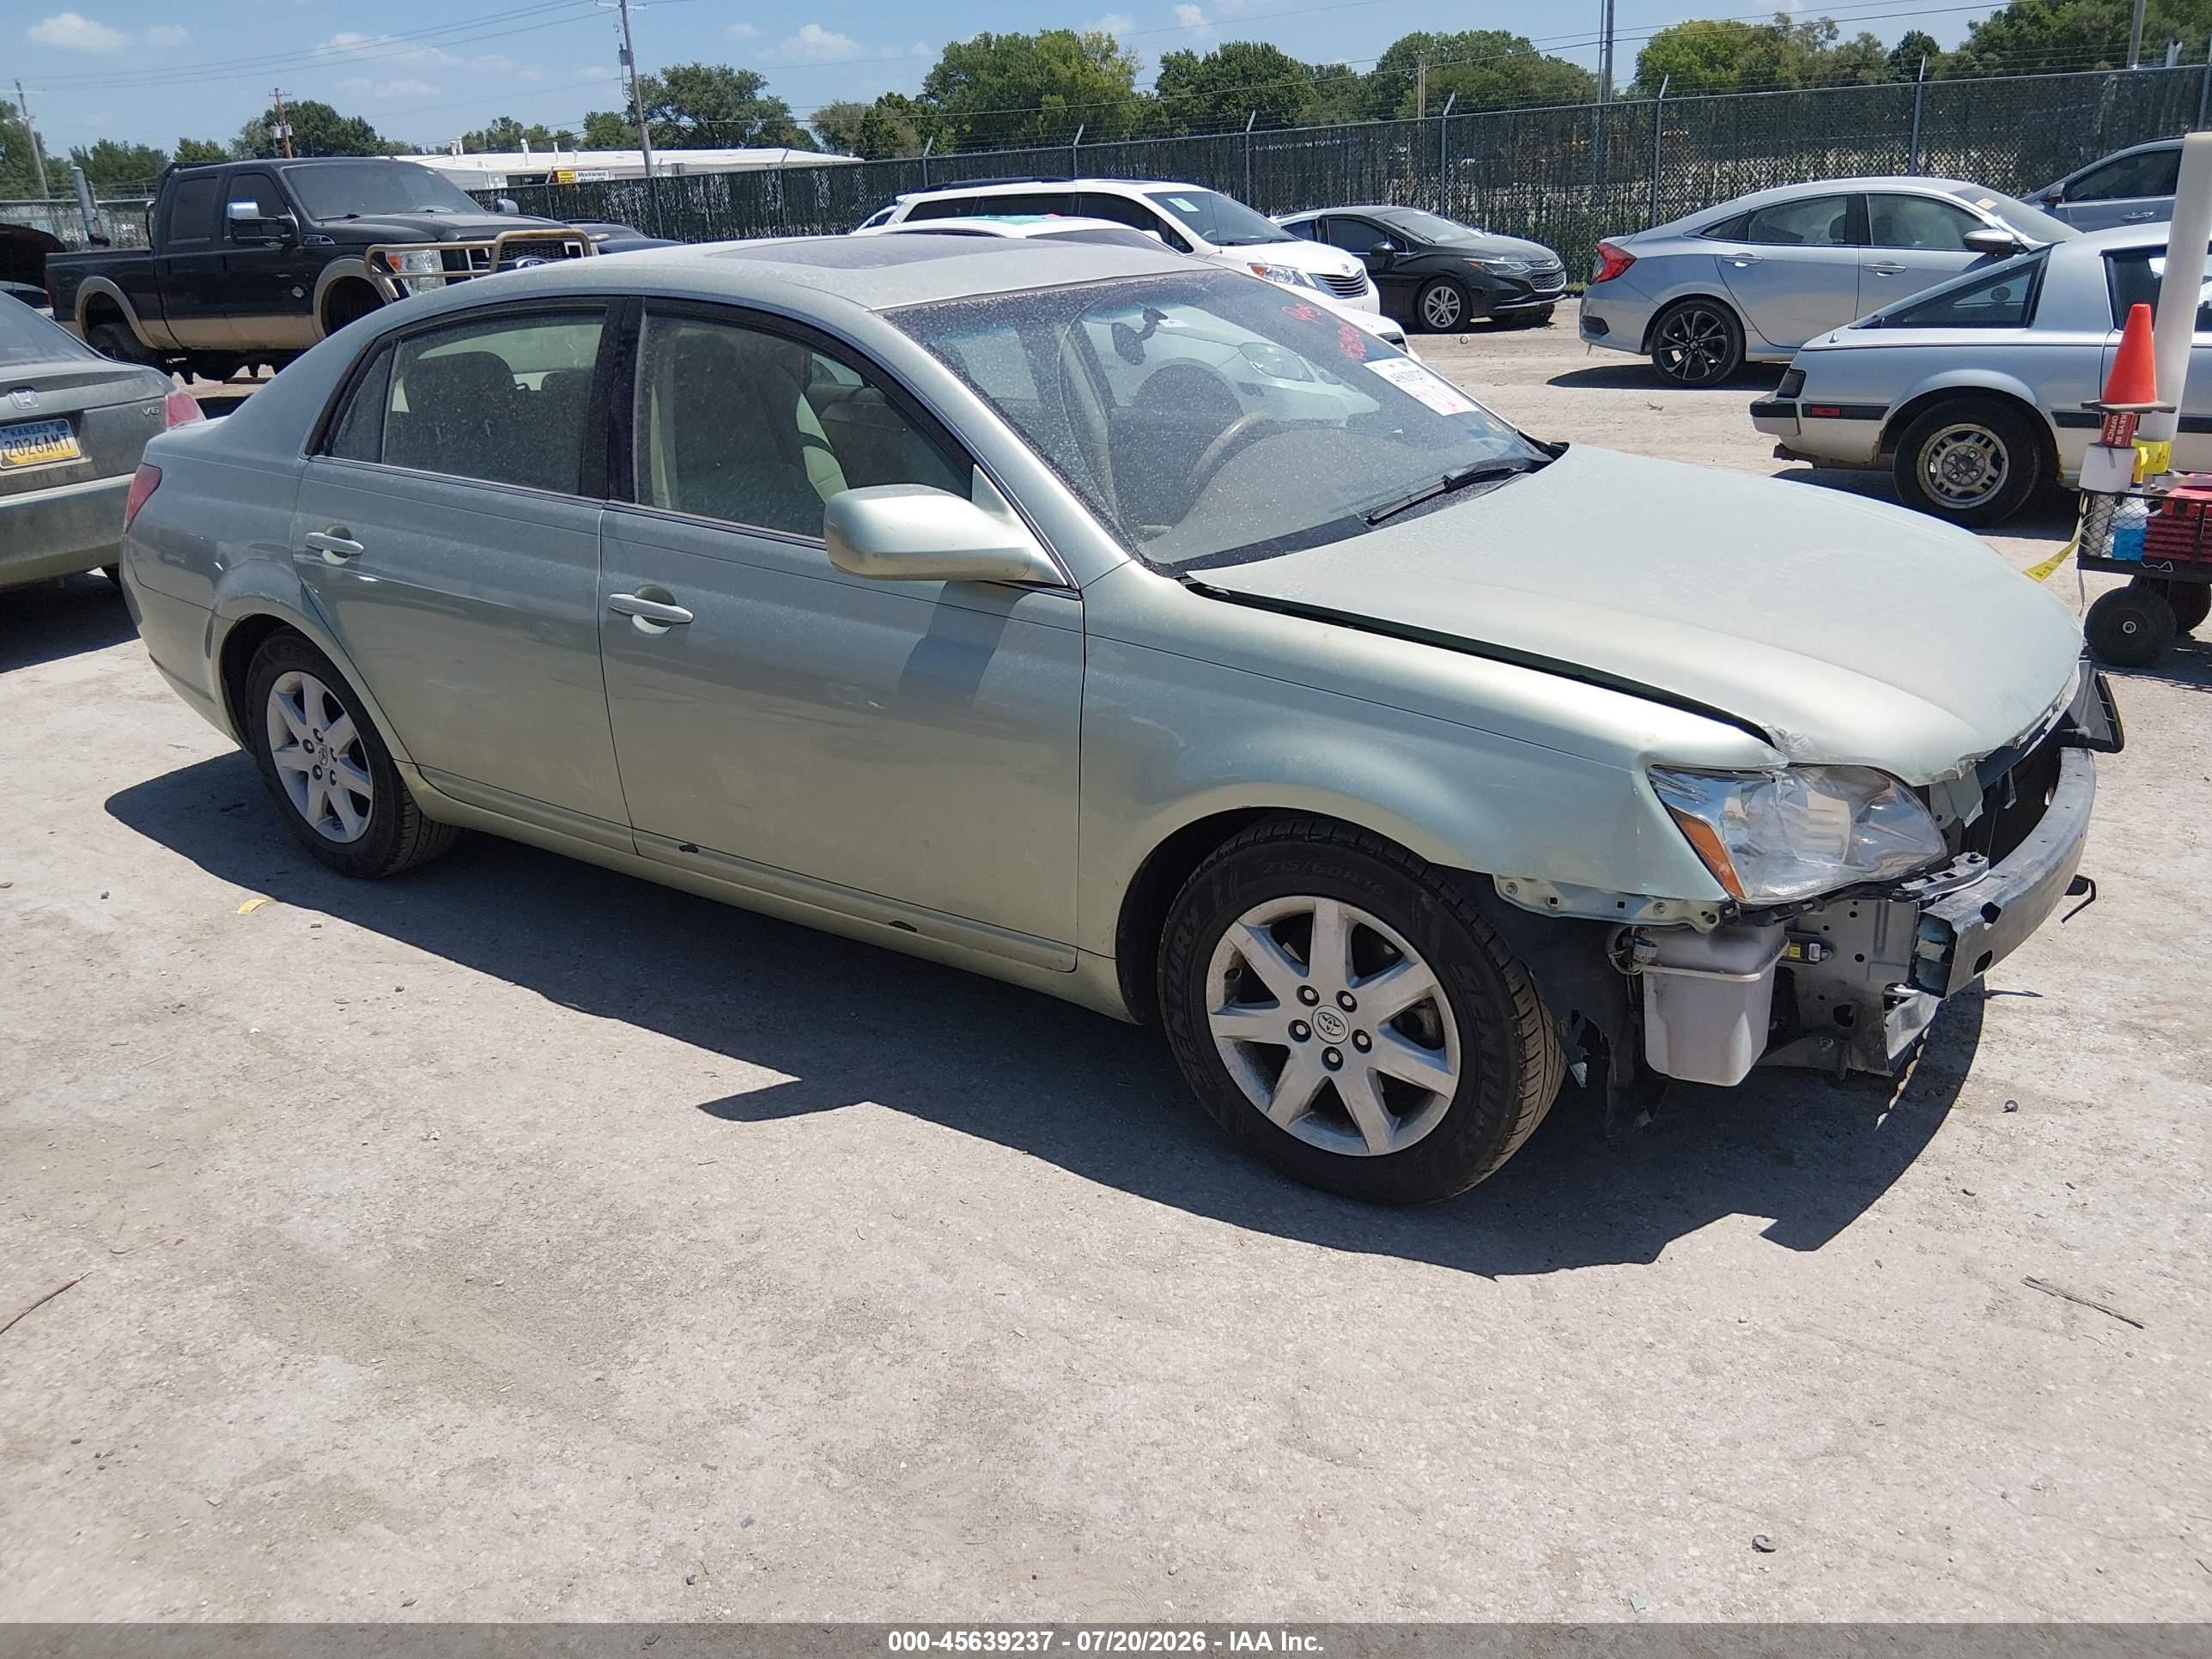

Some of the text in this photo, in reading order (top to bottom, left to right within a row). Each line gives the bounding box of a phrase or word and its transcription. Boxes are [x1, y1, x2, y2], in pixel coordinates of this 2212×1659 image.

[141, 406, 160, 416] V6
[10, 423, 50, 437] KANSAS
[2106, 415, 2118, 442] OFFICE
[2114, 414, 2129, 445] KEYS IN
[4, 432, 71, 459] 2026AMT
